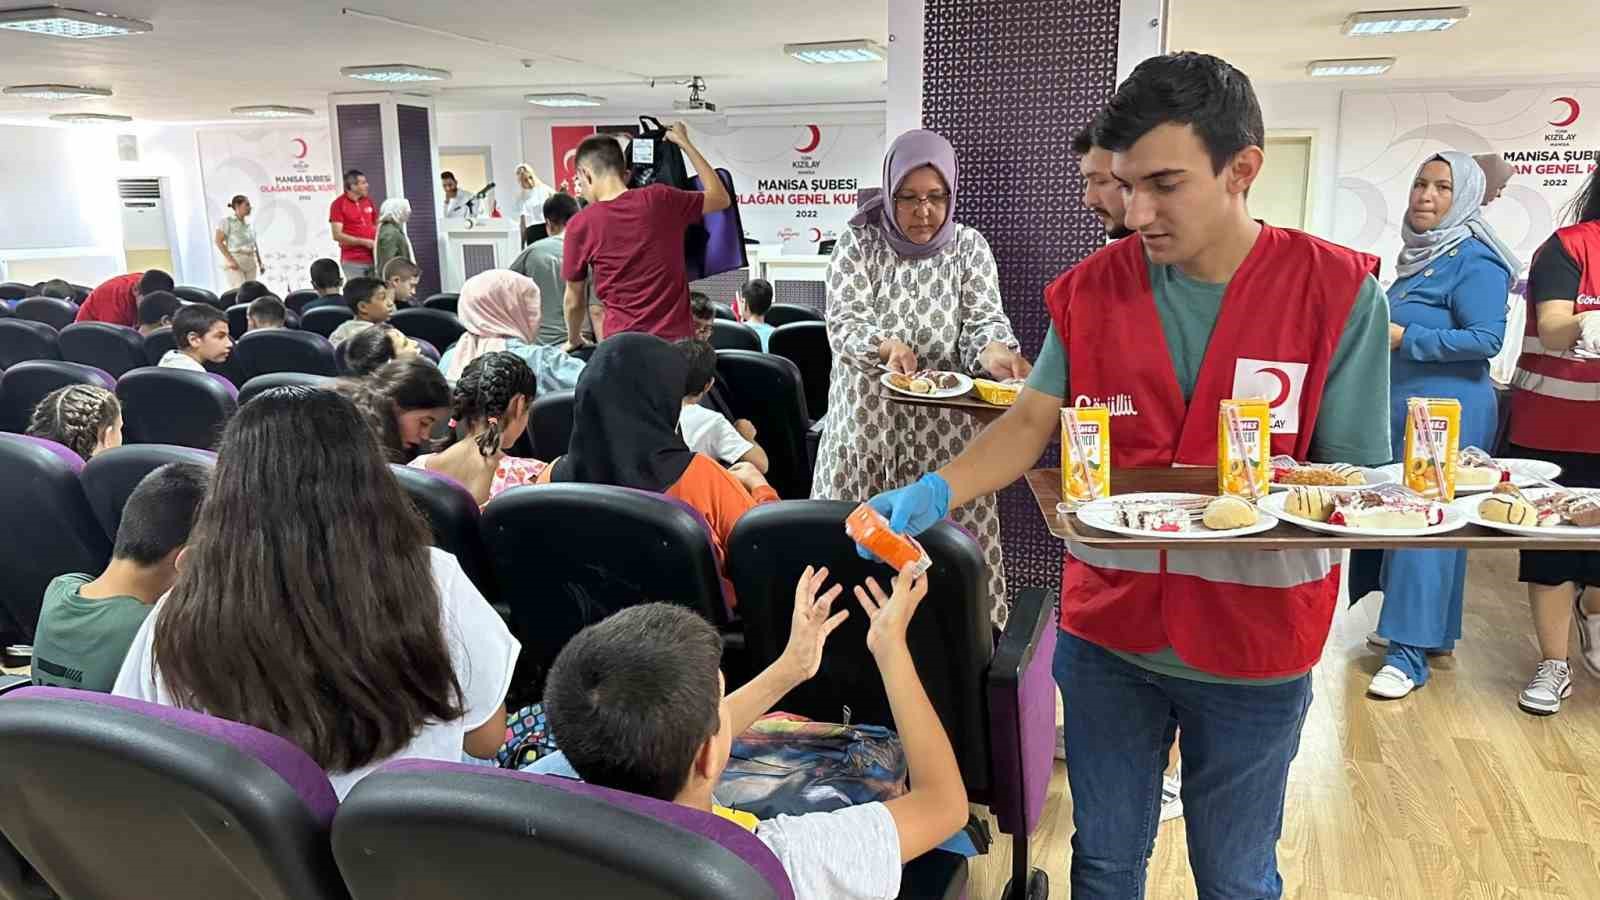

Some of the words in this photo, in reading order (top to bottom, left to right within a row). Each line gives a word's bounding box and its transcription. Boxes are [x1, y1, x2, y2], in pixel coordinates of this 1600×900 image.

[1544, 134, 1577, 142] KIZILAY
[792, 160, 821, 168] KIZILAY
[1535, 164, 1584, 175] GENEL
[1542, 179, 1568, 187] 2022
[736, 191, 785, 205] LAĞAN
[788, 193, 831, 205] GENEL
[795, 210, 818, 218] 2022
